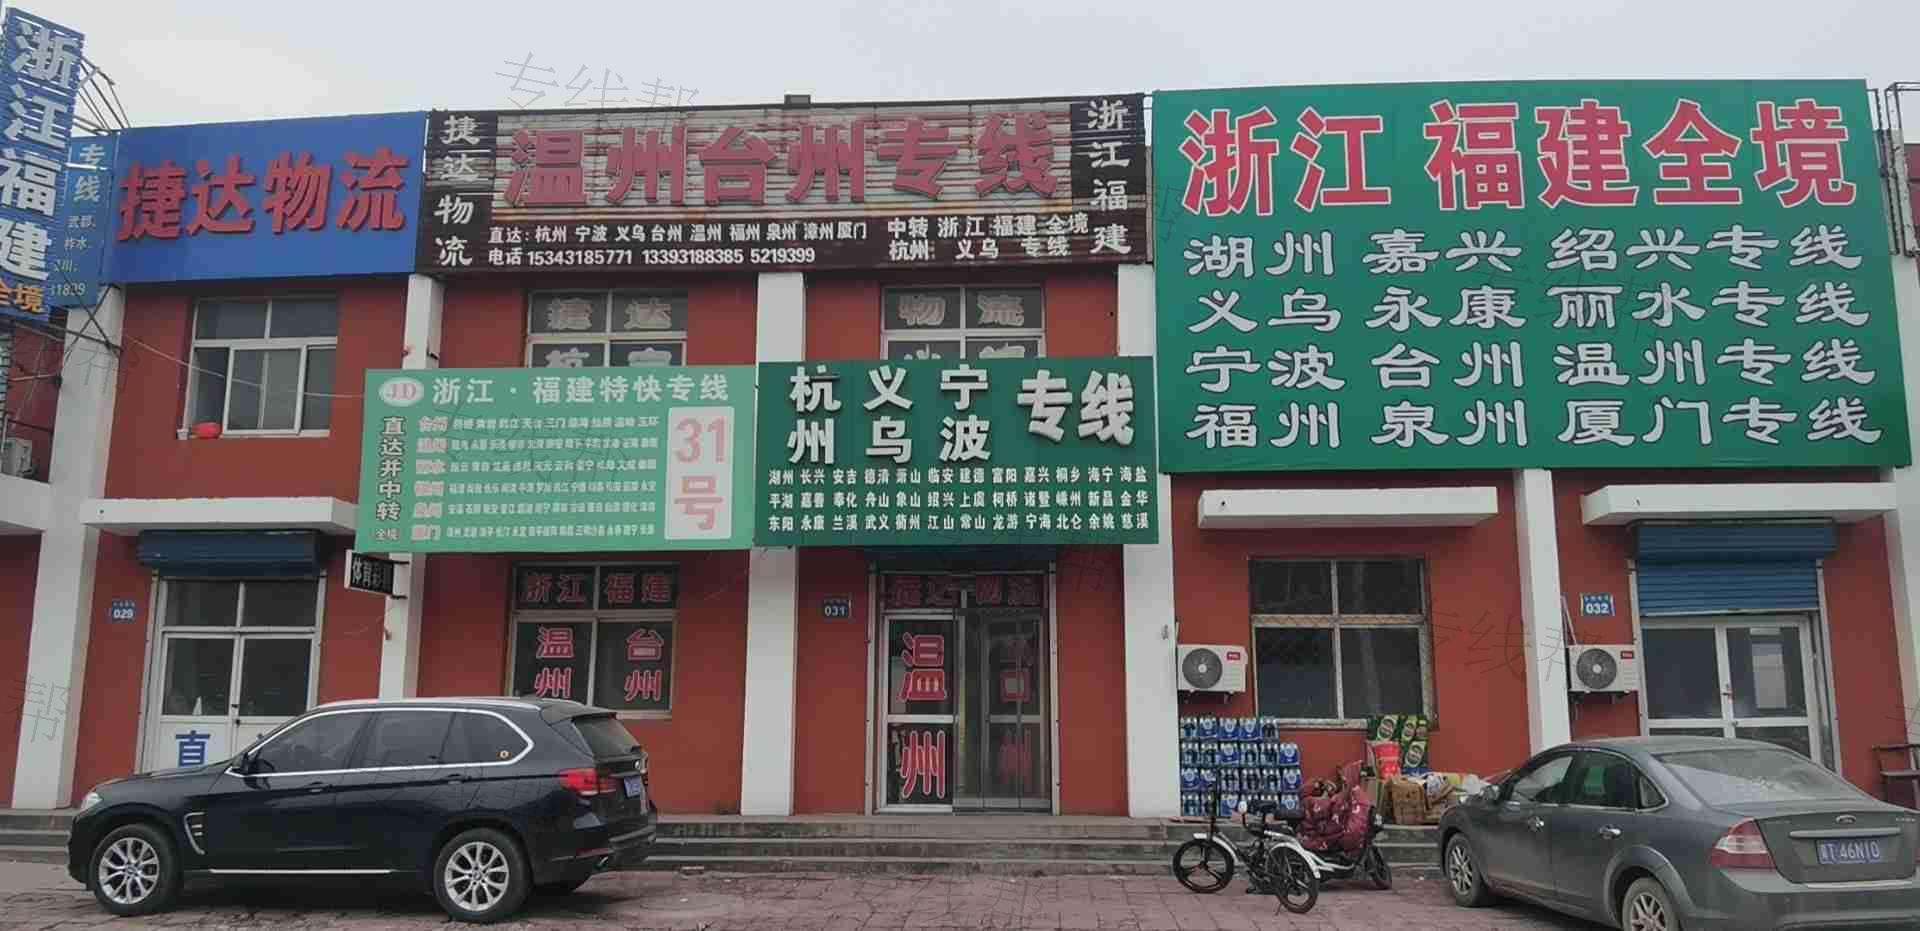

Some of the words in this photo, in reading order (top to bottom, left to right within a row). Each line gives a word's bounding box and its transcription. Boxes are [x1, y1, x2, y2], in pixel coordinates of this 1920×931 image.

[72, 142, 104, 203] 专线
[432, 114, 482, 267] 捷达物流
[503, 115, 1058, 207] 温州台州专线
[1086, 98, 1132, 256] 浙江福建
[1179, 105, 1391, 216] 浙江
[1424, 98, 1855, 211] 福建全境
[117, 148, 410, 243] 捷达物流
[888, 217, 929, 238] 中转
[937, 215, 986, 238] 浙江
[993, 213, 1038, 236] 福建
[1046, 212, 1090, 234] 全境
[488, 248, 523, 266] 电话
[527, 250, 633, 265] 15343185771
[641, 249, 745, 264] 13393188385
[750, 247, 817, 263] 5219399
[575, 226, 608, 242] 宁波
[616, 224, 646, 242] 义乌
[651, 225, 683, 242] 台州
[690, 223, 722, 242] 温州
[729, 223, 761, 241] 福州
[766, 223, 797, 241] 泉州
[804, 222, 834, 240] 漳州
[837, 221, 867, 240] 厦门
[955, 238, 999, 259] 义乌
[1021, 236, 1072, 257] 专线
[1184, 231, 1335, 278] 湖州
[1362, 228, 1522, 275] 嘉兴
[1546, 223, 1863, 272] 绍兴专线
[1187, 288, 1342, 334] 义乌
[1364, 285, 1527, 331] 永康
[1545, 280, 1869, 329] 丽水专线
[1187, 344, 1345, 391] 宁波
[1371, 341, 1525, 389] 台州
[1554, 338, 1877, 387] 温州专线
[788, 364, 843, 464] 杭州
[863, 364, 914, 464] 义乌
[938, 363, 992, 464] 宁波
[1016, 369, 1135, 447] 专线
[1187, 401, 1341, 450] 福州
[1371, 399, 1528, 448] 泉州
[1559, 395, 1883, 447] 厦门专线
[376, 416, 405, 521] 直达并中转
[768, 469, 794, 484] 湖州
[800, 469, 825, 484] 长兴
[832, 469, 857, 484] 安吉
[864, 469, 889, 484] 德清
[928, 469, 954, 484] 临安
[959, 466, 984, 483] 建德
[992, 466, 1017, 483] 富阳
[1024, 466, 1050, 483] 嘉兴
[1056, 466, 1081, 483] 桐乡
[1088, 466, 1113, 483] 海宁
[1120, 466, 1147, 483] 海盐
[768, 492, 793, 508] 平湖
[865, 492, 889, 508] 舟山
[928, 492, 954, 508] 绍兴
[992, 491, 1017, 507] 柯桥
[1088, 491, 1113, 507] 新昌
[1120, 491, 1148, 507] 金华
[768, 514, 794, 531] 东阳
[800, 514, 825, 531] 永康
[865, 514, 890, 531] 武义
[928, 514, 954, 531] 江山
[960, 513, 985, 529] 常山
[992, 513, 1018, 529] 龙游
[1025, 513, 1051, 529] 宁海
[1056, 513, 1082, 529] 北仑
[1586, 602, 1610, 615] 032
[535, 625, 575, 699] 温州
[623, 626, 665, 702] 台州
[898, 631, 948, 799] 温州
